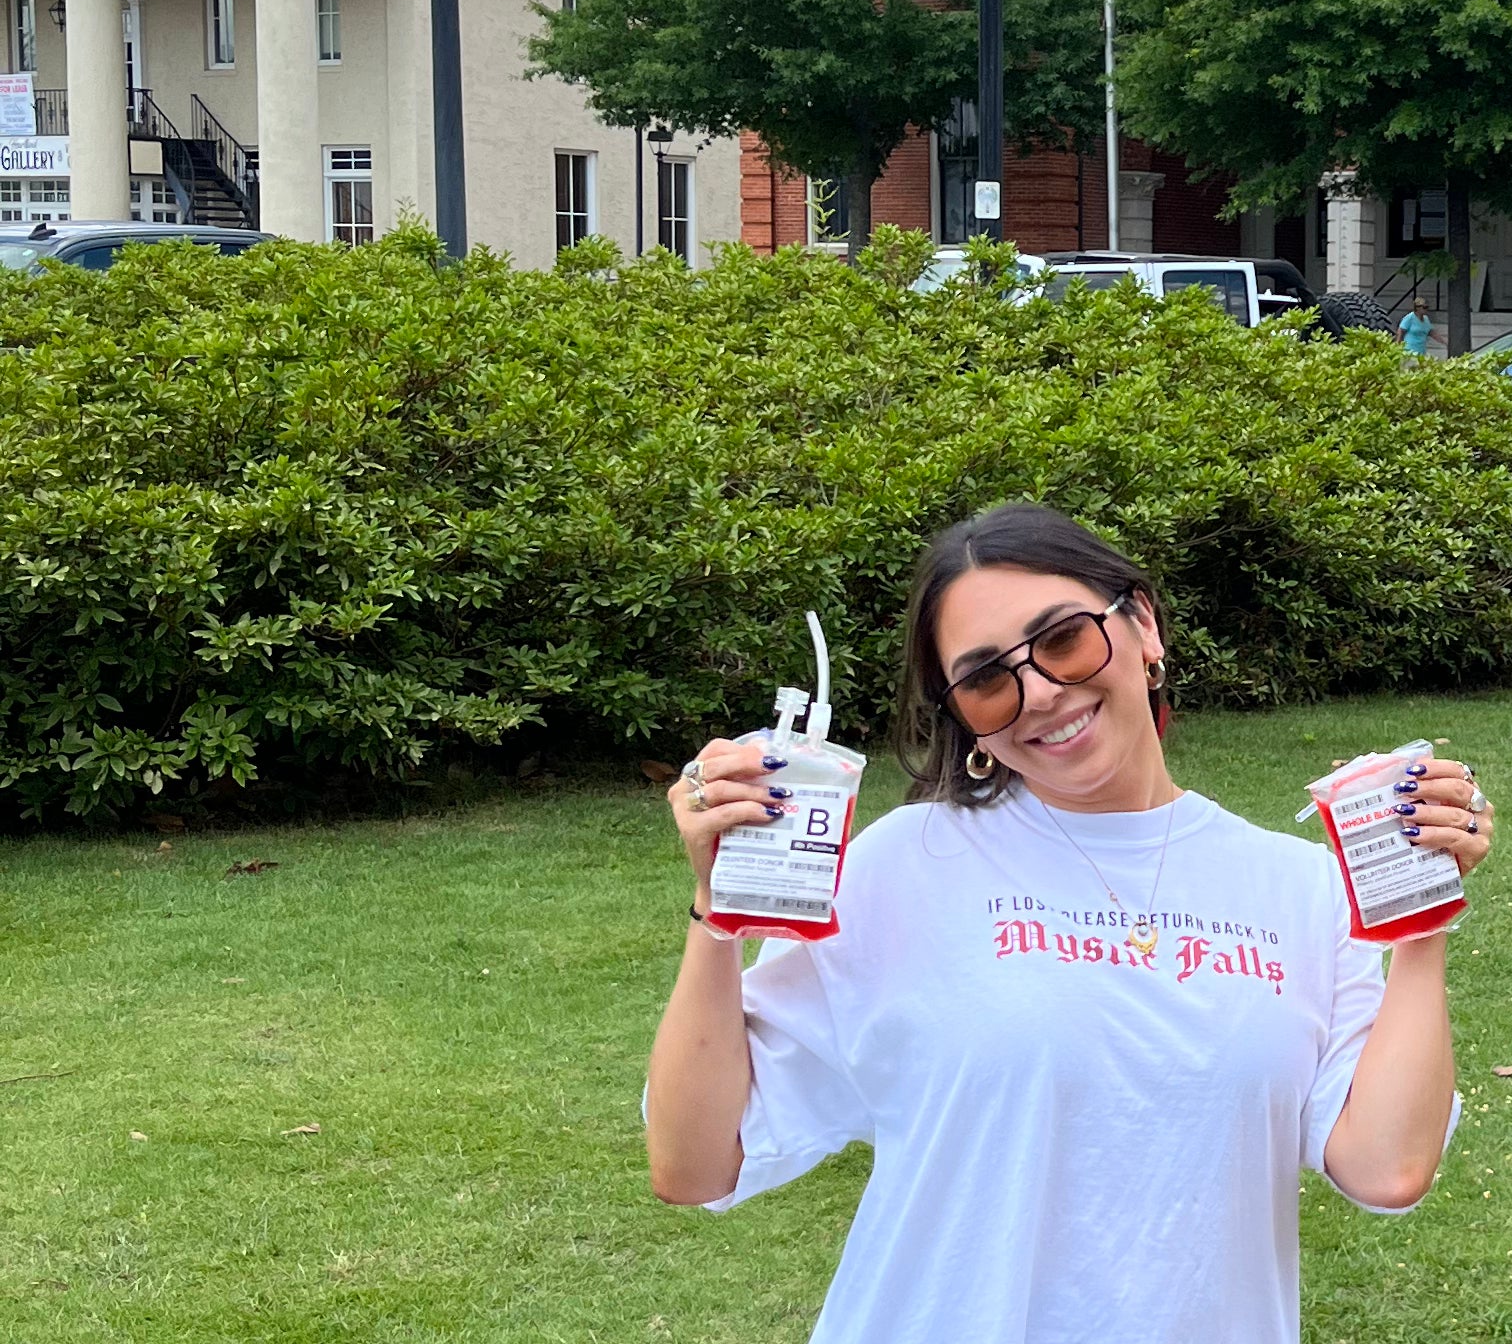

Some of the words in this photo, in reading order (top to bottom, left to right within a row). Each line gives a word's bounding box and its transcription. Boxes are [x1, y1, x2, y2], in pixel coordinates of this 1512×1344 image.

[1, 145, 55, 170] GALLERY
[806, 808, 830, 837] B
[1340, 813, 1373, 831] WHOLE
[988, 897, 1003, 914] IF
[1013, 895, 1055, 911] LOS
[1212, 921, 1255, 940] BACK
[1260, 928, 1279, 945] TO
[1175, 935, 1285, 986] Falls
